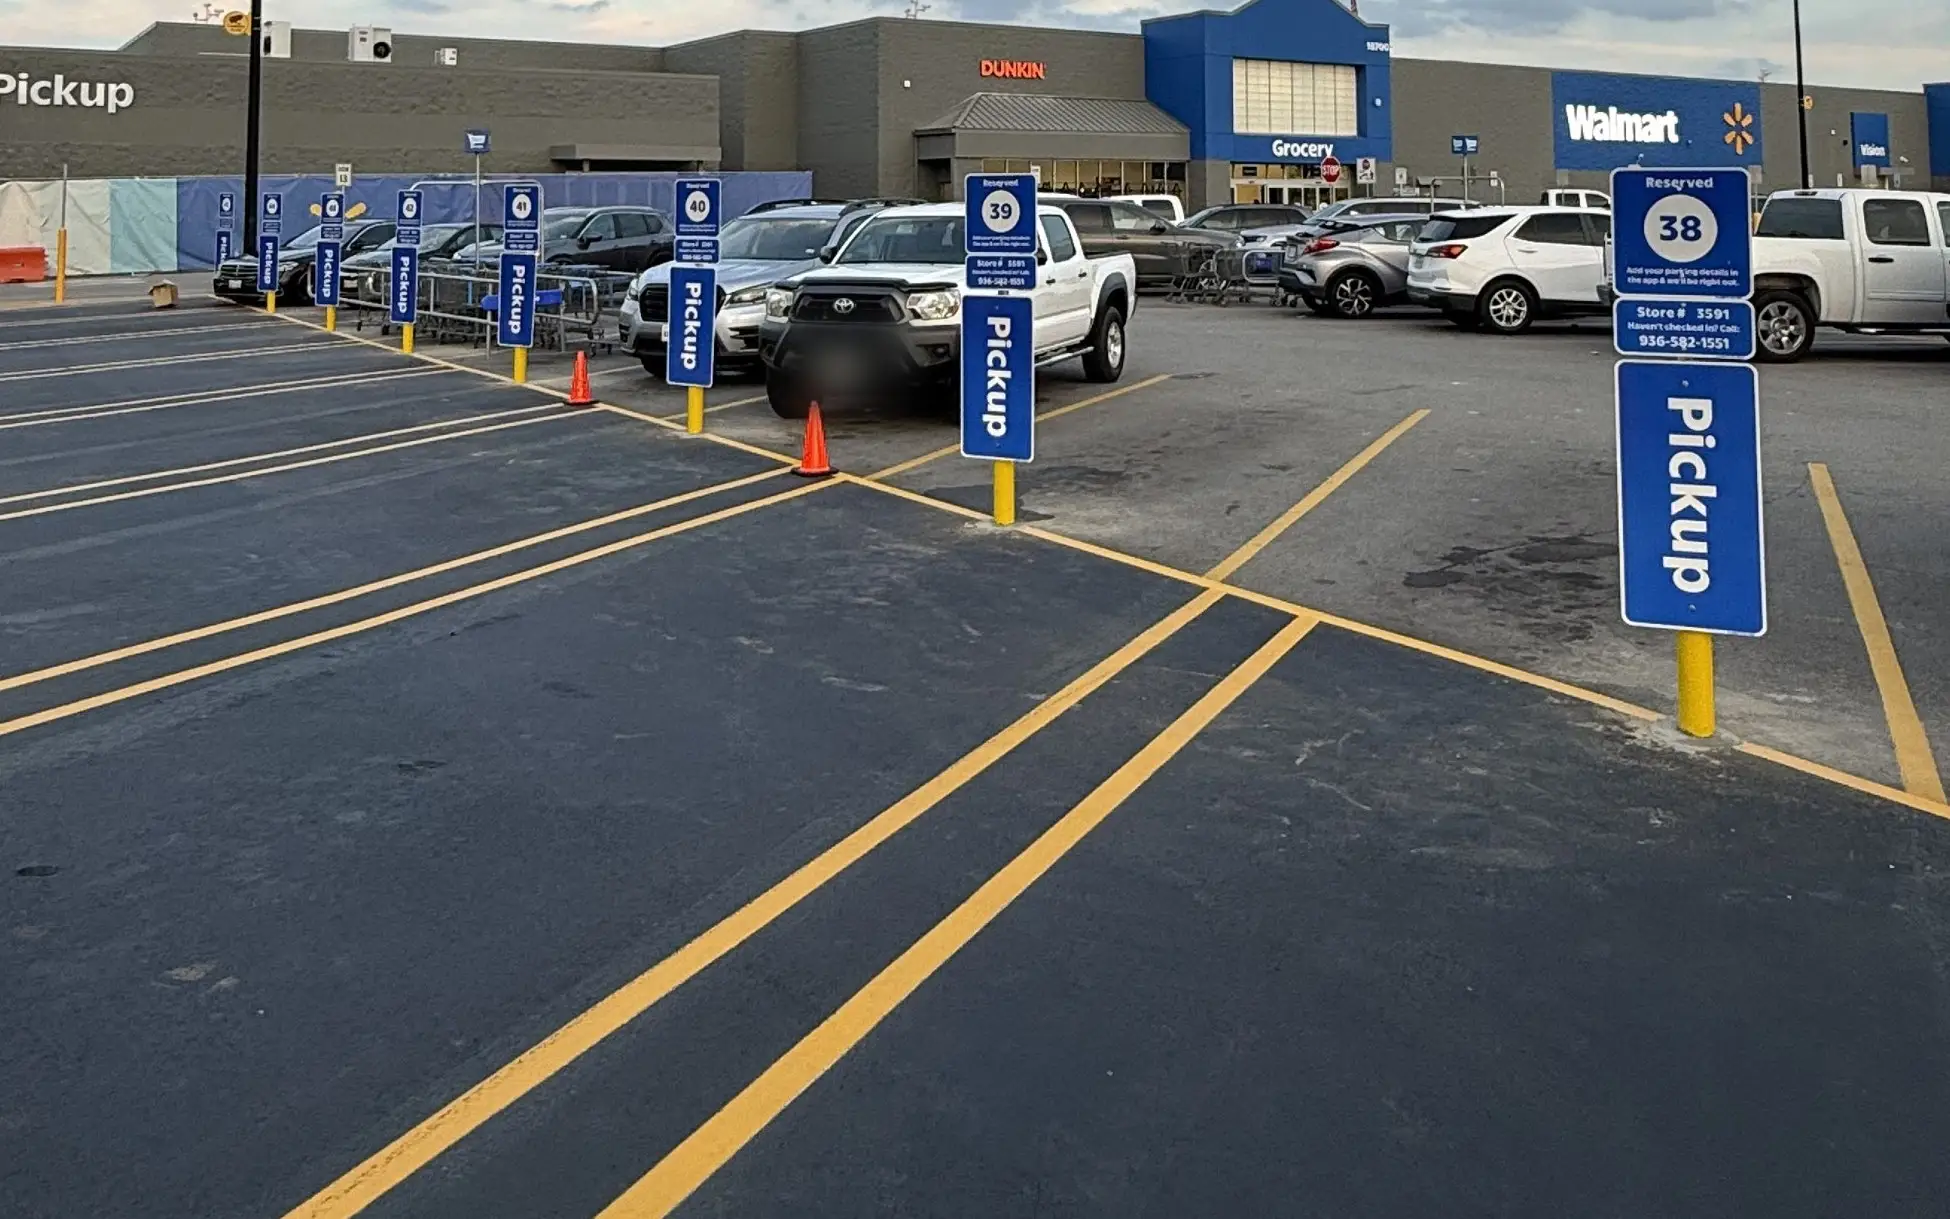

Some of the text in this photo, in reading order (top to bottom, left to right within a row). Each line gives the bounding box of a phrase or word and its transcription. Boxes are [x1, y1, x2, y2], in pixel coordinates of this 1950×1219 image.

[0, 72, 134, 113] Pickup
[1565, 104, 1679, 143] Walmart
[1272, 139, 1334, 157] Grocery
[1322, 164, 1340, 176] STOP
[1645, 177, 1714, 189] Reserved
[516, 201, 527, 212] 41
[689, 200, 706, 213] 40
[989, 203, 1012, 220] 39
[1659, 215, 1702, 242] 38
[263, 242, 273, 284] Pickup
[322, 249, 334, 298] Pickup
[396, 256, 410, 313] Pickup
[508, 265, 526, 334] Pickup
[680, 282, 702, 370] Pickup
[1637, 307, 1730, 320] Store # 3591
[1664, 323, 1704, 332] checked
[1639, 335, 1730, 349] 936-582-1551
[982, 316, 1012, 437] Pickup
[1662, 397, 1718, 594] Pickup
